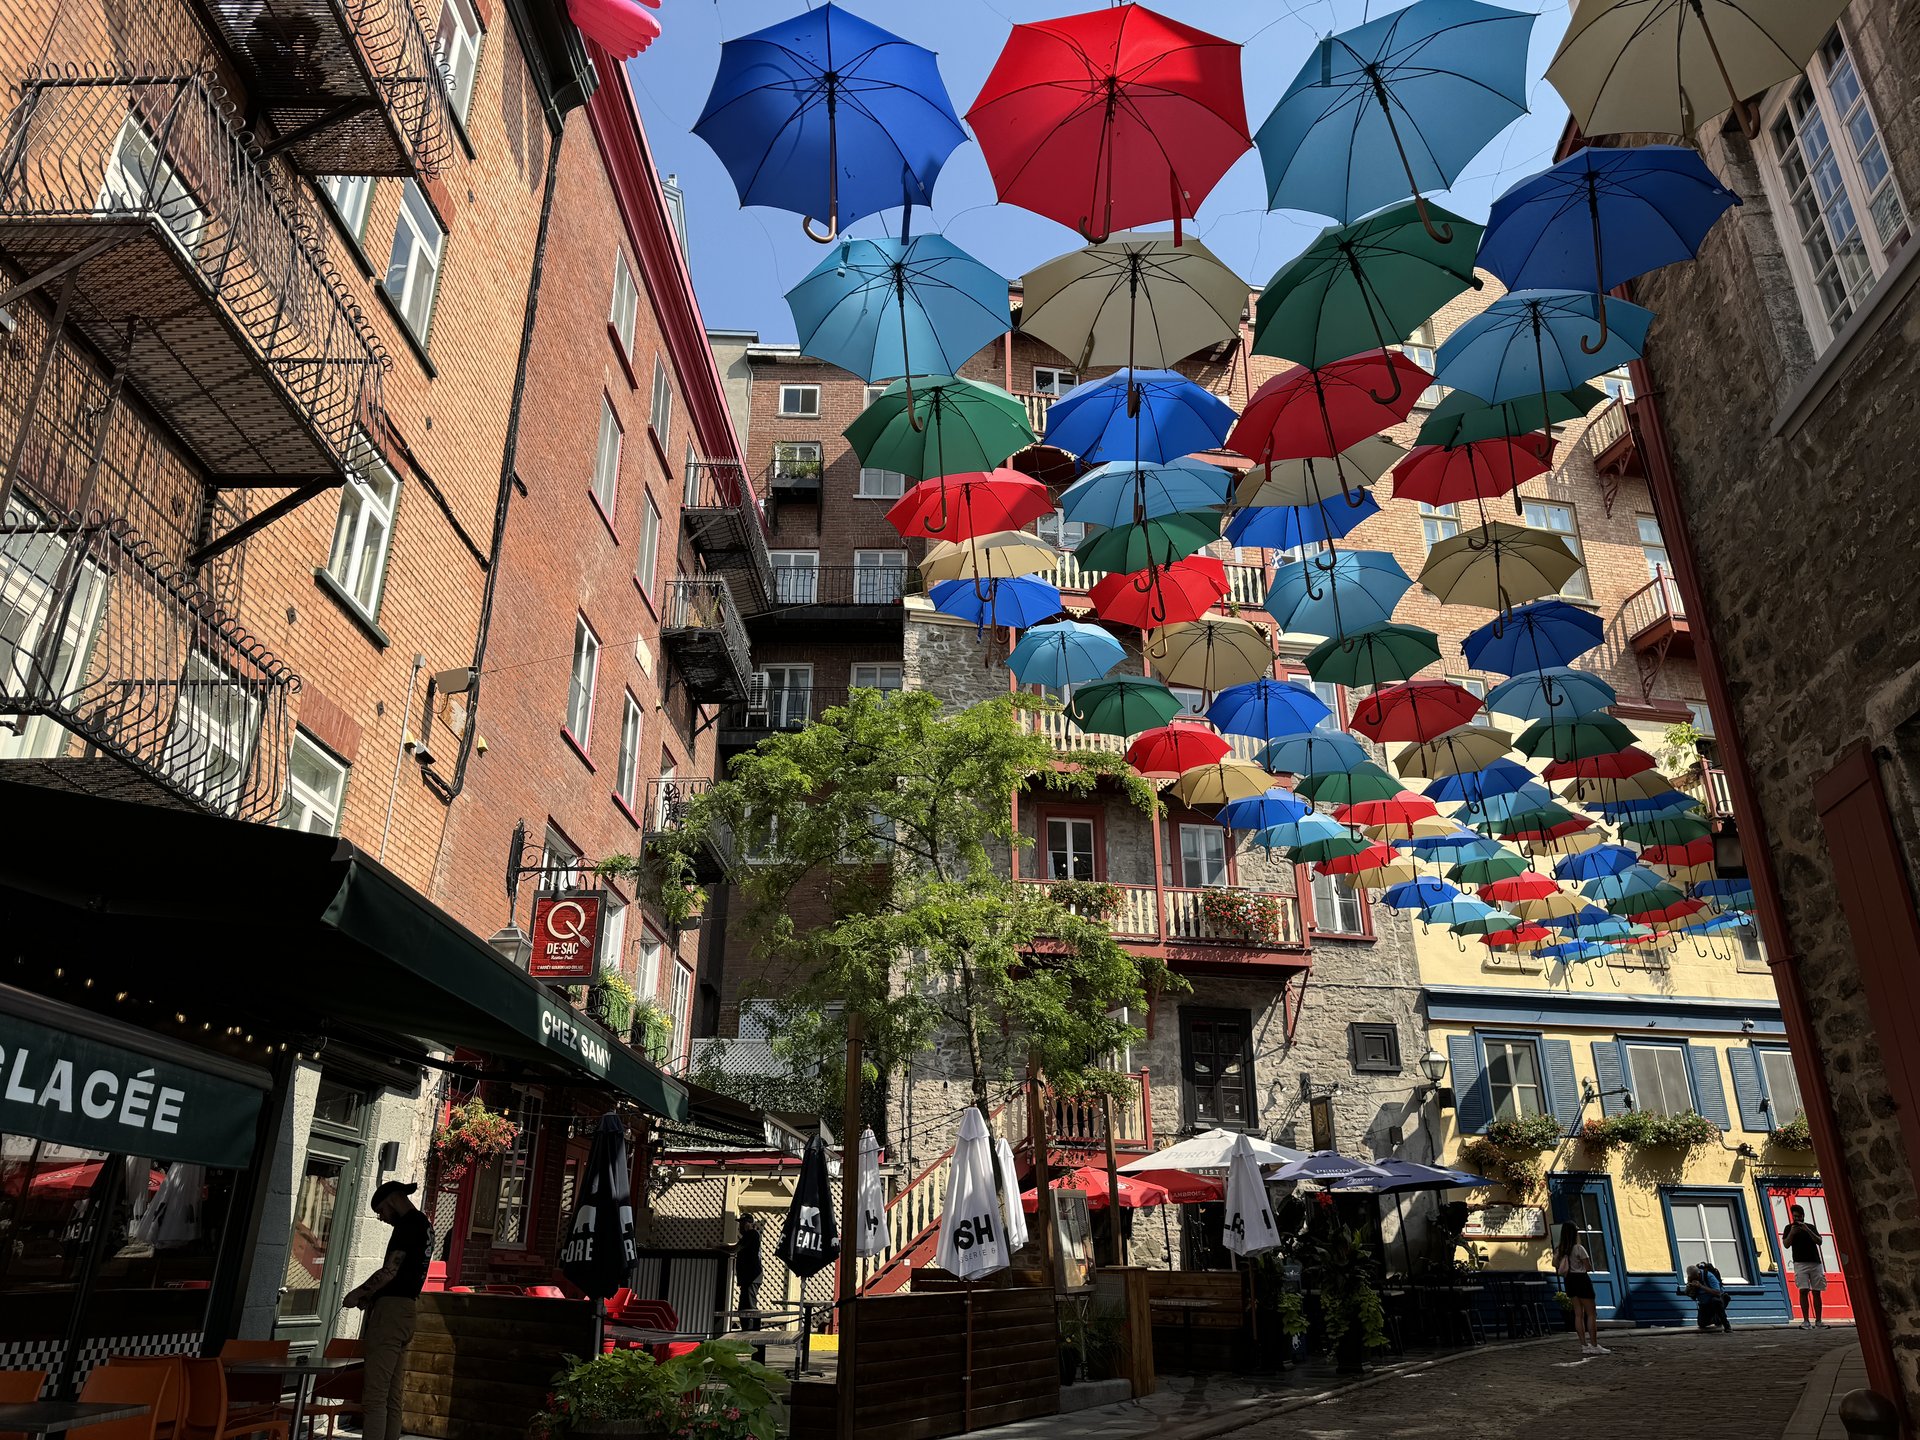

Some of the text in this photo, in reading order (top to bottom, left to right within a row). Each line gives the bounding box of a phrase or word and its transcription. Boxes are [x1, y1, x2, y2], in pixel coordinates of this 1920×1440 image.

[547, 901, 592, 948] Q
[541, 1010, 613, 1072] CHEZ SAMY
[0, 1045, 186, 1135] LACÉE
